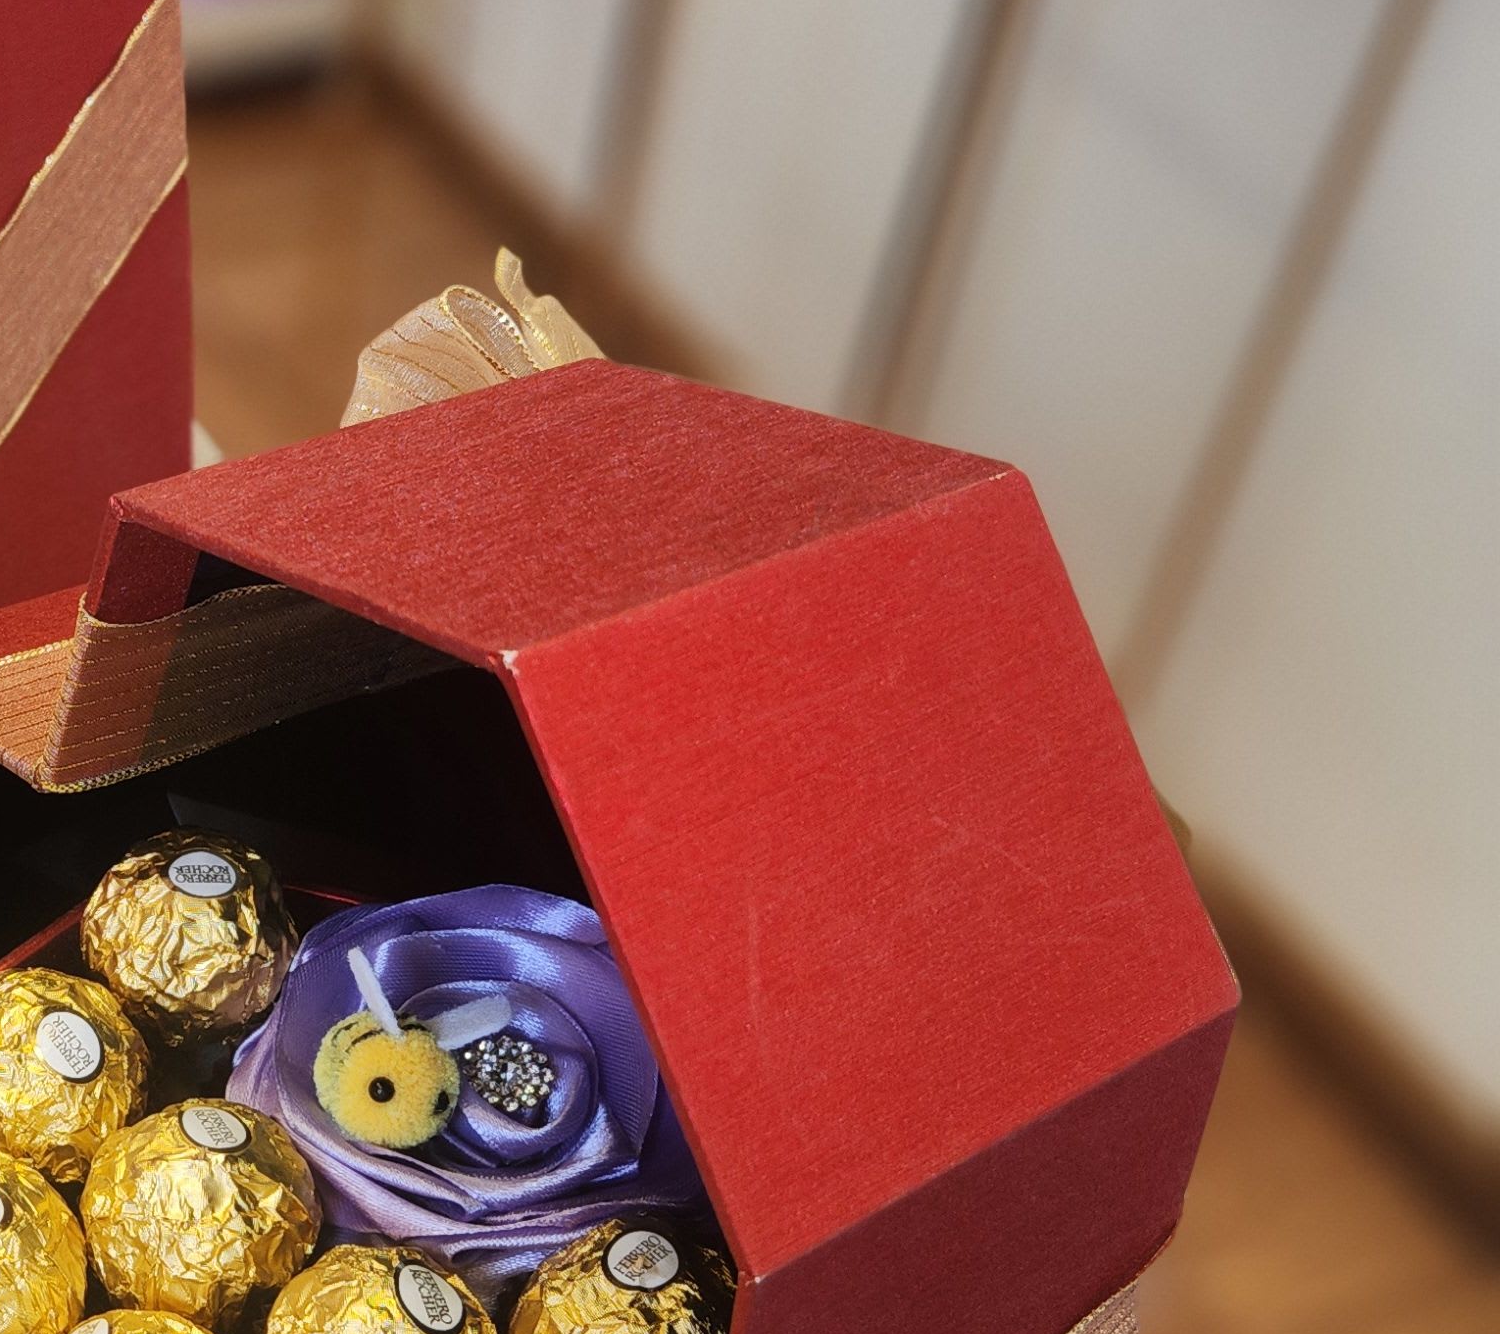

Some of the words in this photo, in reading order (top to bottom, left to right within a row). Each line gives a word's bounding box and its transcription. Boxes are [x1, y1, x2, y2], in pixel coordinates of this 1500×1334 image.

[175, 873, 232, 884] FERRERO
[176, 865, 229, 875] ROCHER
[42, 1022, 86, 1075] FERRERO
[52, 1014, 95, 1068] ROCHER
[192, 1109, 221, 1146] ROCHER
[204, 1108, 238, 1144] FERRERO
[612, 1234, 661, 1276] FERRERO
[624, 1243, 675, 1282] ROCHER
[409, 1268, 441, 1325] ROCHER
[419, 1268, 453, 1325] FERRERO
